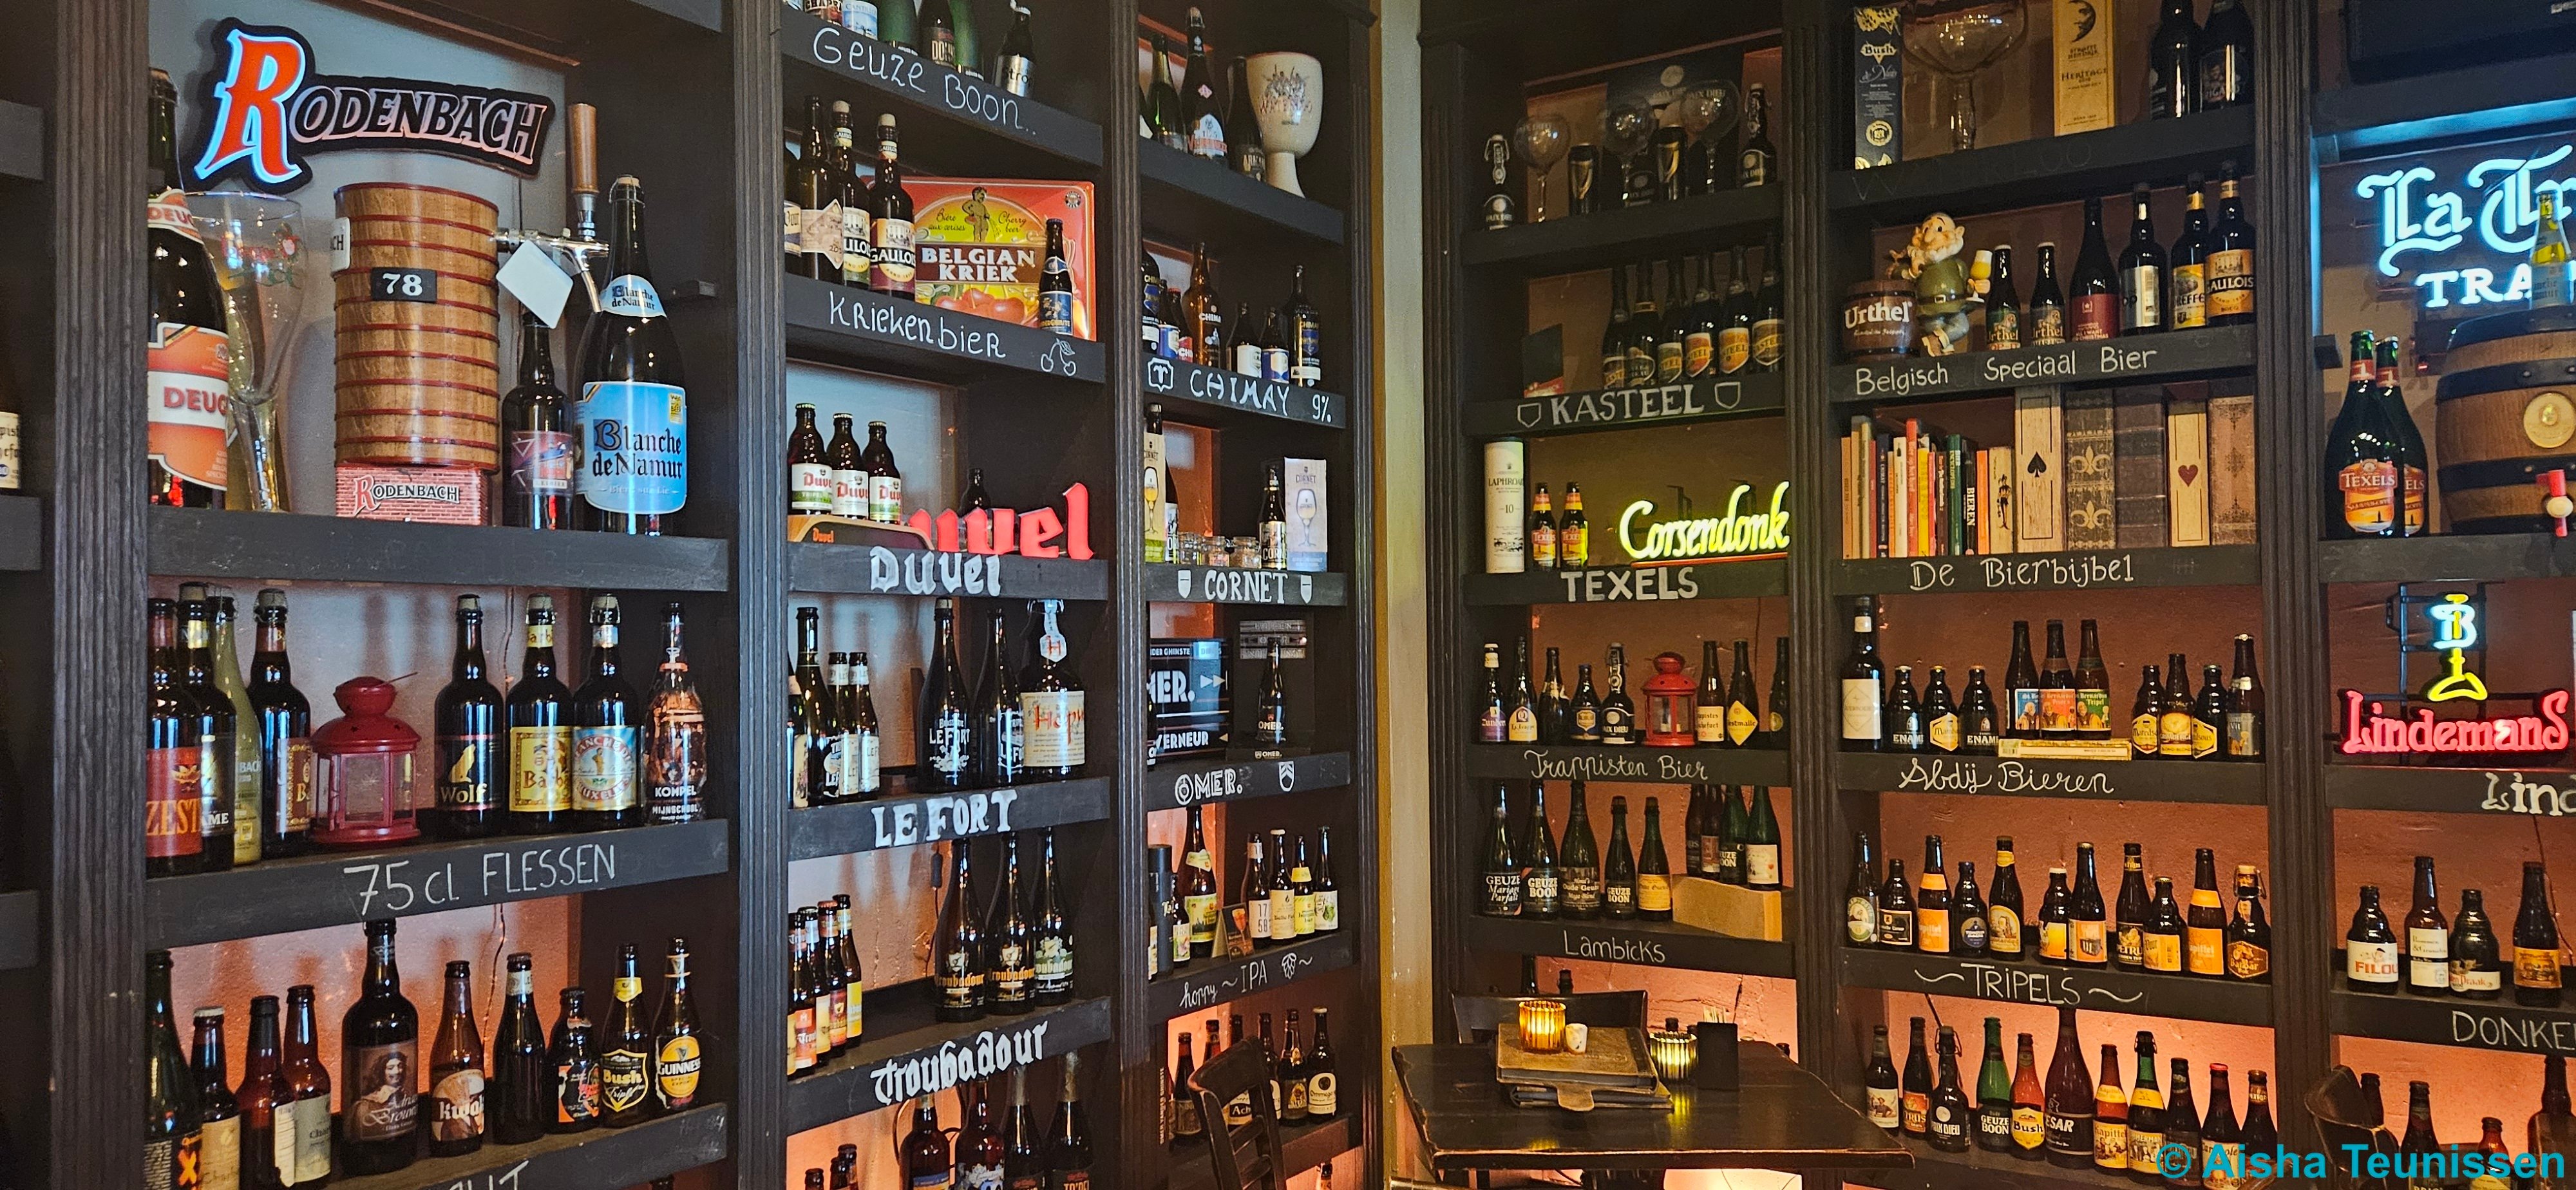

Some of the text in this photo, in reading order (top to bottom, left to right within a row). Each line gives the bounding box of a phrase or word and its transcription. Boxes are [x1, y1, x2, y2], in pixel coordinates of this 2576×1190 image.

[813, 26, 927, 93] Geuze
[998, 210, 1027, 226] Cherry
[2357, 144, 2576, 277] La Tr
[1005, 222, 1021, 233] beer
[921, 246, 1036, 268] BELGIAN
[382, 272, 423, 296] 78
[938, 263, 1019, 283] KRIEK
[1844, 301, 1909, 328] Urthel
[1855, 345, 2158, 399] Belgisch Speciaal Bier
[1189, 368, 1332, 423] CHIMAY 9%
[1550, 384, 1705, 426] KASTEEL
[593, 419, 681, 455] Blanche
[592, 451, 683, 480] de Namur
[1296, 473, 1316, 484] CORNET
[2343, 473, 2396, 488] TEXELS
[354, 475, 460, 516] RODENBACH
[1499, 504, 1514, 514] 10
[1966, 487, 1976, 526] BIEREN
[812, 527, 835, 543] Duvel
[907, 482, 1094, 560] uvel
[1620, 480, 1790, 560] Corsendonk
[869, 545, 1001, 597] Duvel
[1560, 567, 1699, 603] TEXELS
[1910, 554, 2136, 591] De Bierbijbel
[1204, 569, 1288, 604] CORNET
[1524, 750, 1649, 780] Trappisten
[1899, 757, 2115, 794] Abdij Bieren
[440, 782, 488, 804] Wolf
[654, 784, 697, 798] KOMPEL
[1175, 768, 1243, 806] OMER.
[871, 789, 1018, 849] LE FORT
[343, 860, 414, 916] 75
[482, 844, 616, 896] FLESSEN
[1486, 874, 1520, 886] GEUZE
[1528, 877, 1558, 889] GEUZE
[1529, 887, 1558, 898] BOON
[1258, 902, 1268, 918] 17
[1240, 959, 1268, 993] IPA
[2452, 1010, 2576, 1052] DONKE
[603, 1069, 643, 1084] Bush
[870, 1020, 1049, 1106] Troubadour
[1980, 1115, 2009, 1126] GEUZE
[1981, 1124, 2009, 1135] BOON
[2013, 1120, 2043, 1133] Bush
